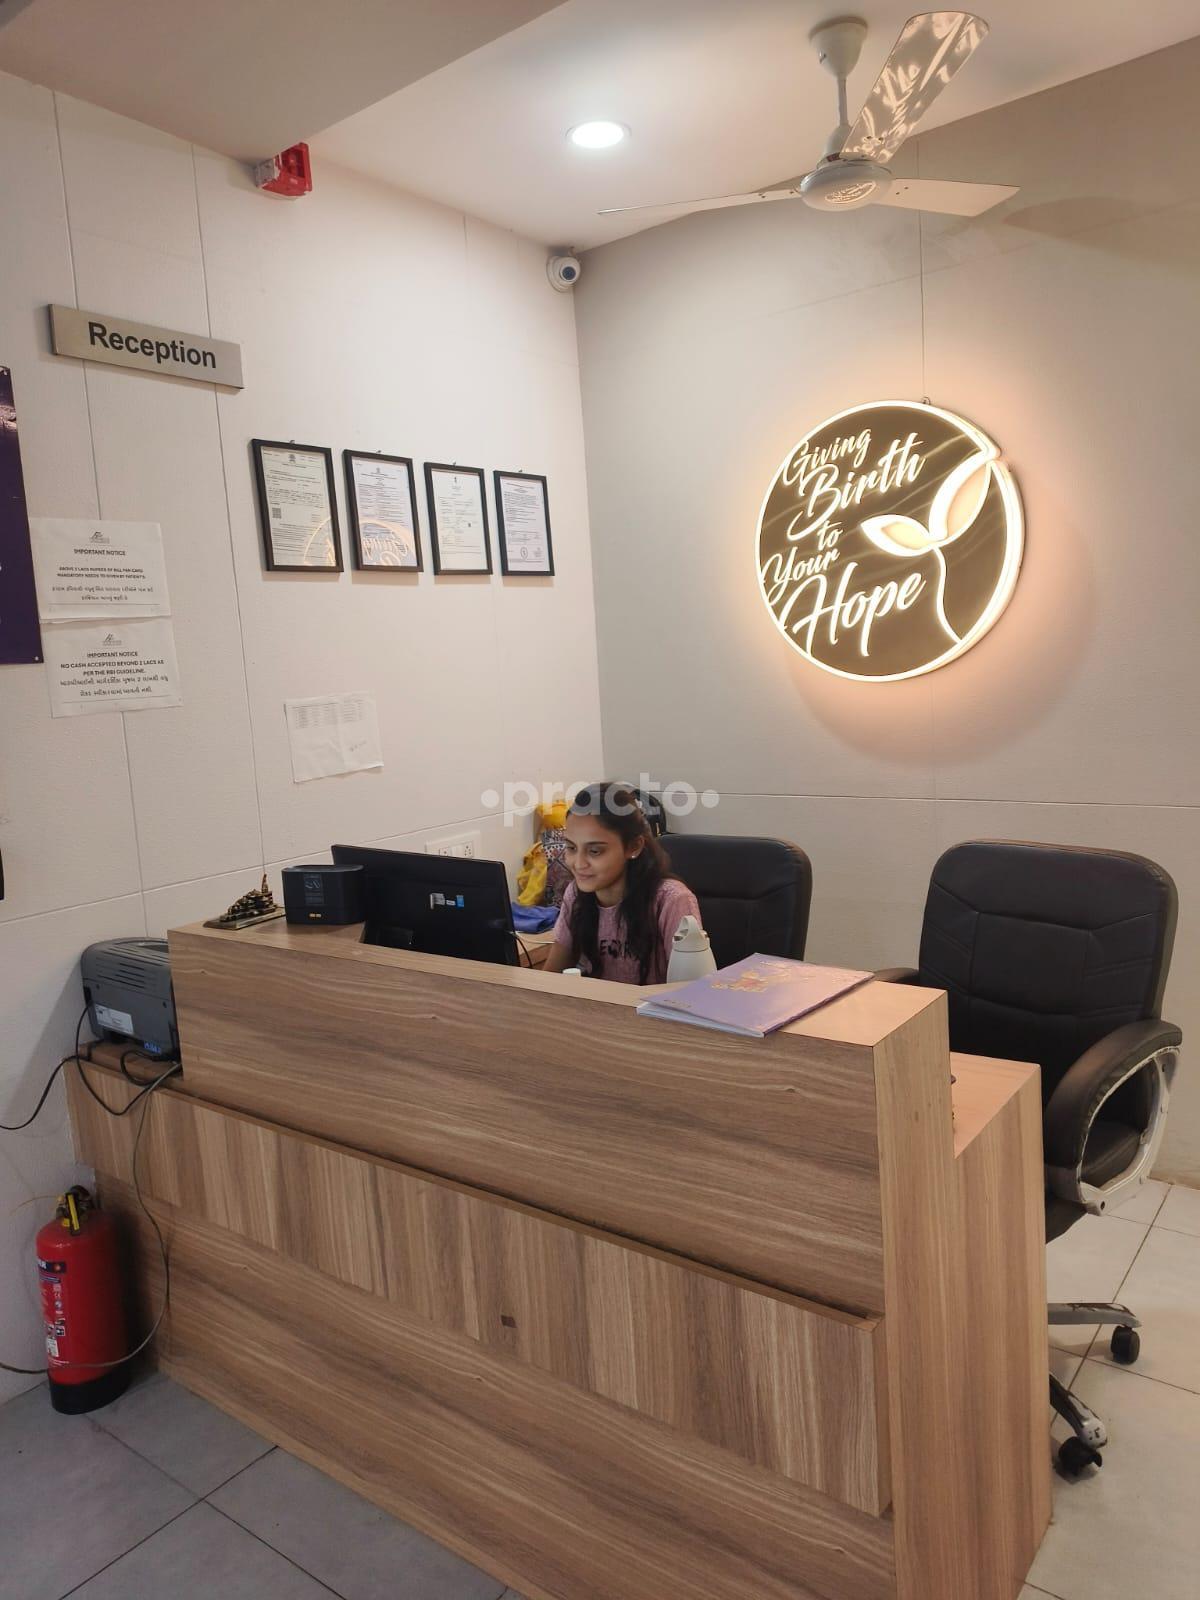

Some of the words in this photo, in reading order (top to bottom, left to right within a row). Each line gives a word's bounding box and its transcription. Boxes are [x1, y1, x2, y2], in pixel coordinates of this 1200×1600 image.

[88, 321, 216, 368] Reception
[783, 428, 871, 485] Giving
[787, 432, 926, 541] Birth
[816, 519, 843, 550] to
[761, 546, 840, 607] Your
[780, 561, 926, 657] Hope
